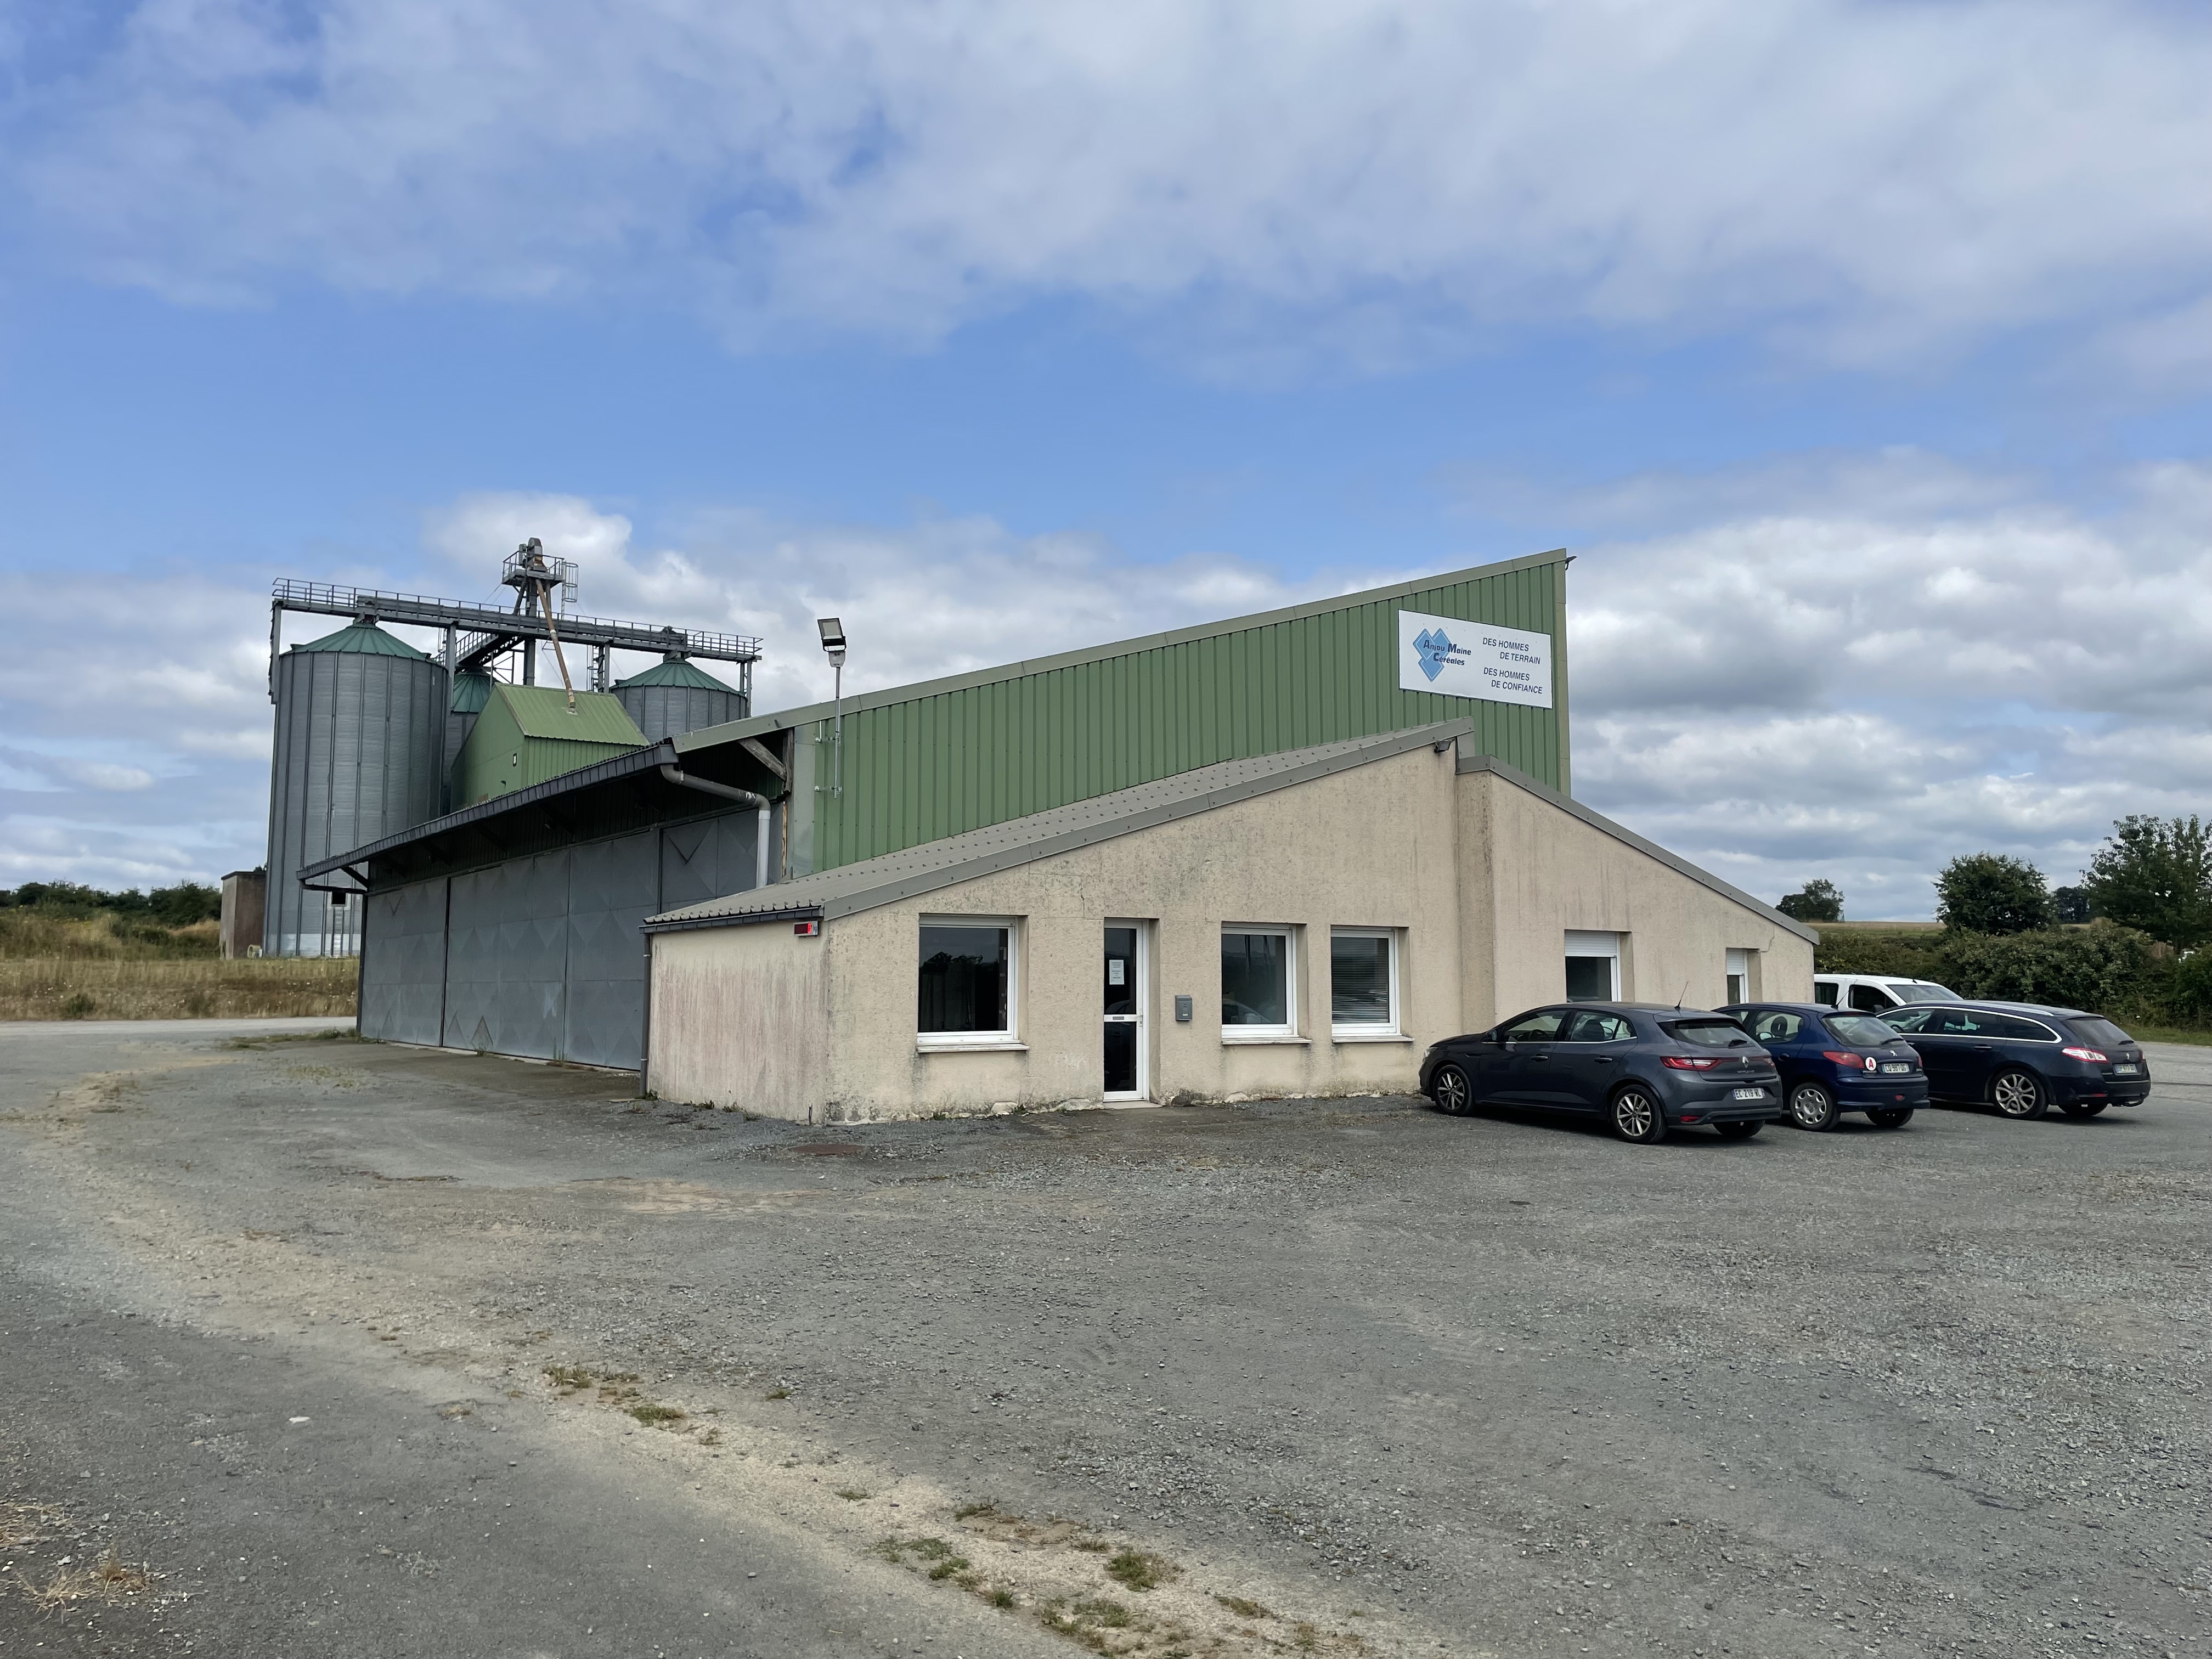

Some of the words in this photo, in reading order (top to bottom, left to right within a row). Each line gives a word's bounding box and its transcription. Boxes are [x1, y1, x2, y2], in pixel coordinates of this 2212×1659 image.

[1423, 639, 1445, 651] Anjou
[1447, 643, 1471, 656] Maine
[1482, 637, 1497, 647] DES
[1498, 640, 1530, 652] HOMMES
[1433, 652, 1465, 665] Céréales
[1499, 651, 1510, 660] DE
[1510, 653, 1541, 665] TERRAIN
[1483, 667, 1498, 676] DES
[1499, 669, 1530, 681] HOMMES
[1491, 679, 1501, 689] DE
[1502, 681, 1543, 695] CONFIANCE
[1869, 1059, 1874, 1068] A
